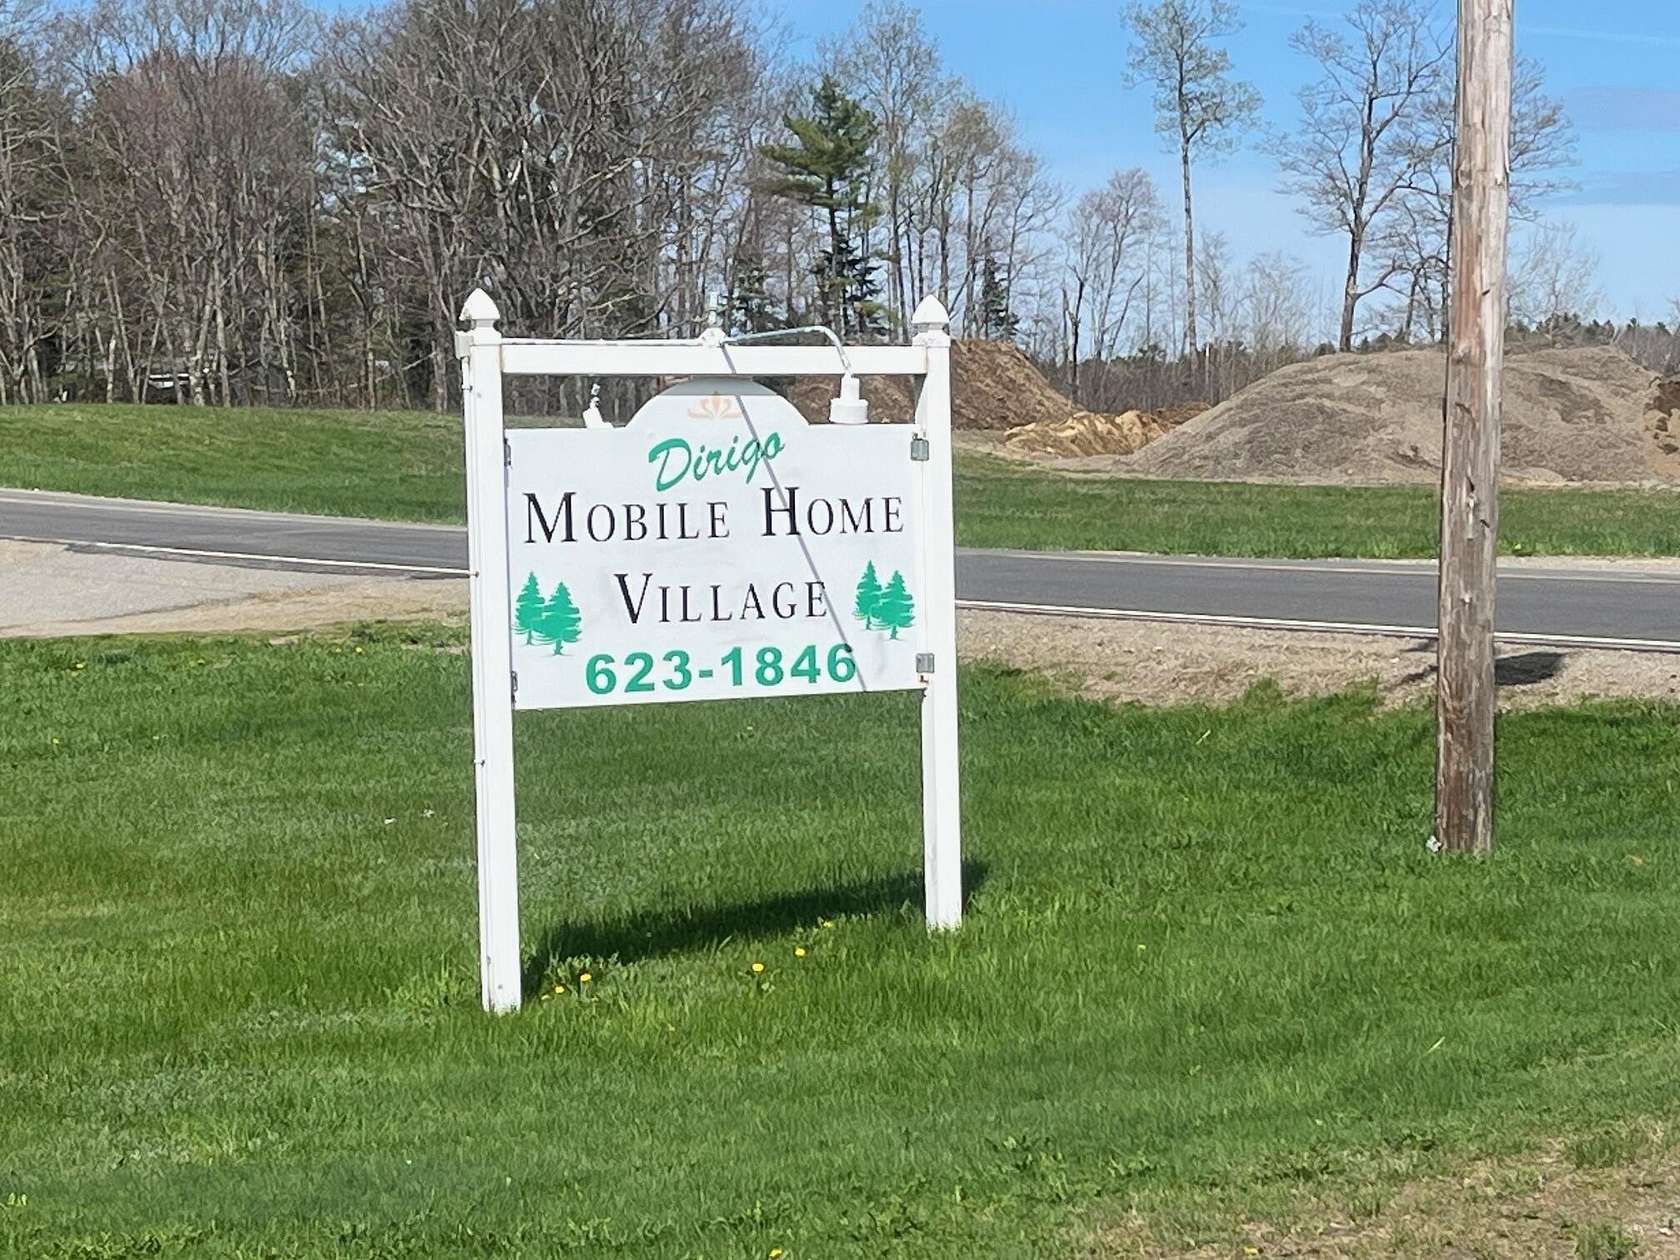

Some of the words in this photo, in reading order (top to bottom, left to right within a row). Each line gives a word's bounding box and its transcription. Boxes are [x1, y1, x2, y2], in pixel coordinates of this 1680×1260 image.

[648, 431, 785, 492] Dirigo
[523, 491, 730, 544] MOBILE
[760, 486, 905, 538] HOME
[614, 572, 828, 624] VILLAGE
[585, 643, 857, 695] 623-1846
